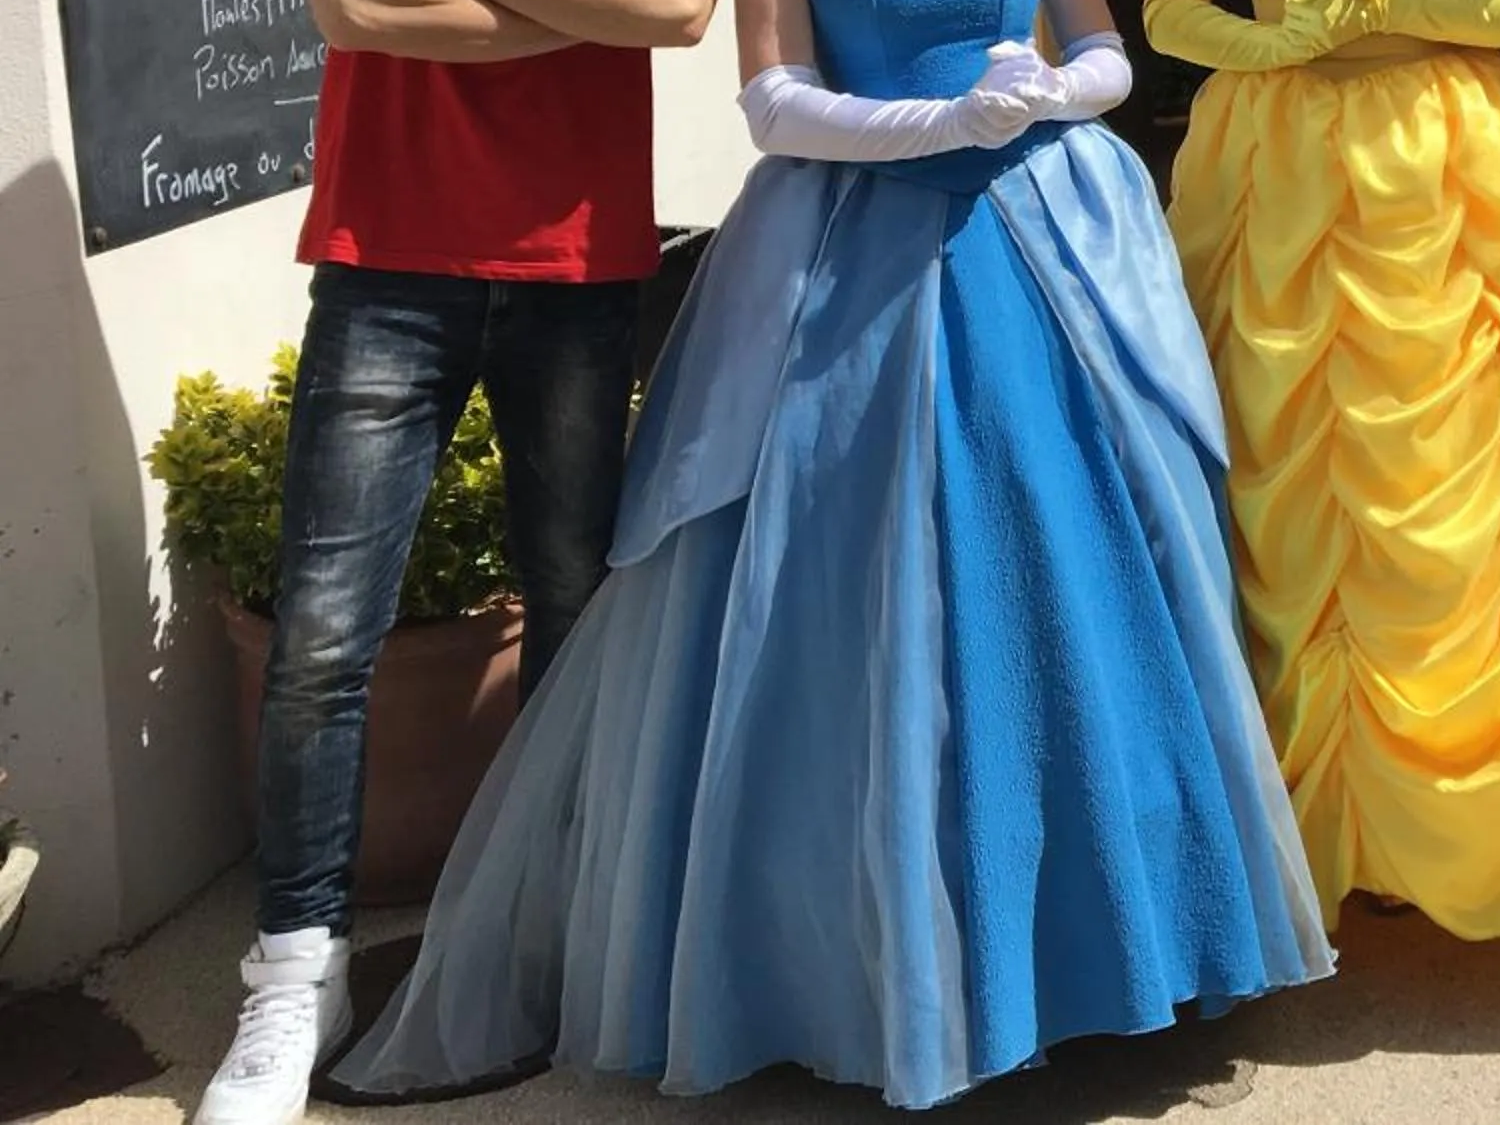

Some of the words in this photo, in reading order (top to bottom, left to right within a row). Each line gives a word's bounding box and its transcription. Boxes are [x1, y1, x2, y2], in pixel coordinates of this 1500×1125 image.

[193, 43, 275, 102] Poisson
[141, 133, 241, 208] Fromage
[257, 151, 281, 175] ou
